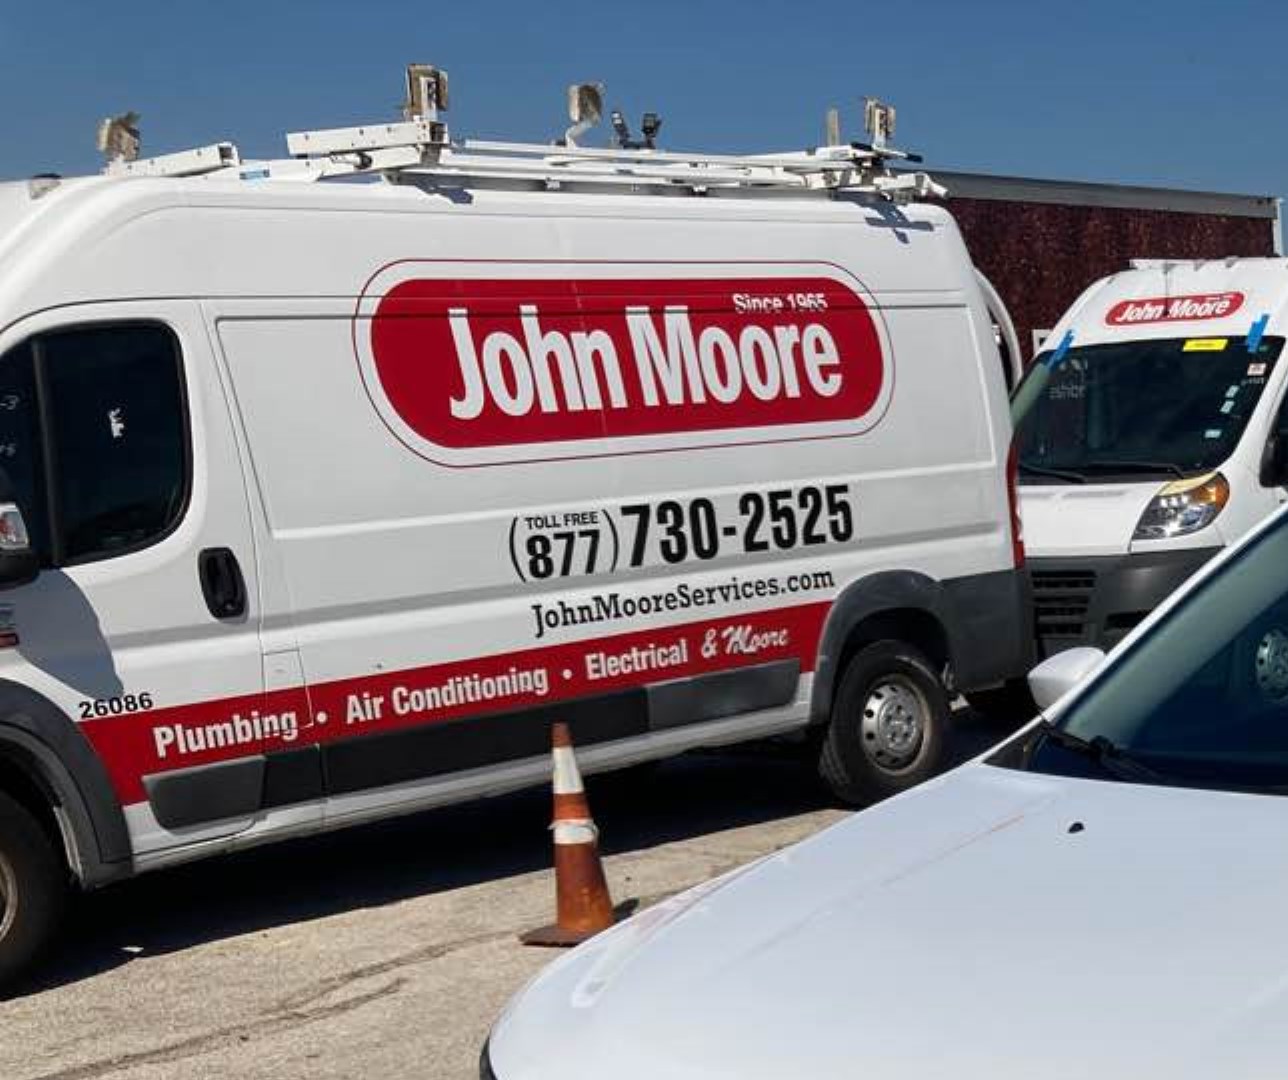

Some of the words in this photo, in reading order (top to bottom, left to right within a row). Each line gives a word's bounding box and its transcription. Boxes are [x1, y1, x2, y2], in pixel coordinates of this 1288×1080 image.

[1115, 302, 1164, 322] John
[1167, 299, 1231, 318] Moore
[448, 305, 628, 420] John
[626, 305, 842, 407] Moore
[525, 515, 561, 529] TOLL
[563, 511, 599, 527] FREE
[531, 570, 835, 638] JohnMooreServices.com
[79, 693, 154, 719] 26086
[153, 708, 298, 758] Plumbing
[346, 694, 384, 724] Air
[391, 666, 549, 715] Conditioning
[585, 639, 689, 681] Electrical
[701, 628, 718, 659] &
[722, 624, 789, 654] Moore
